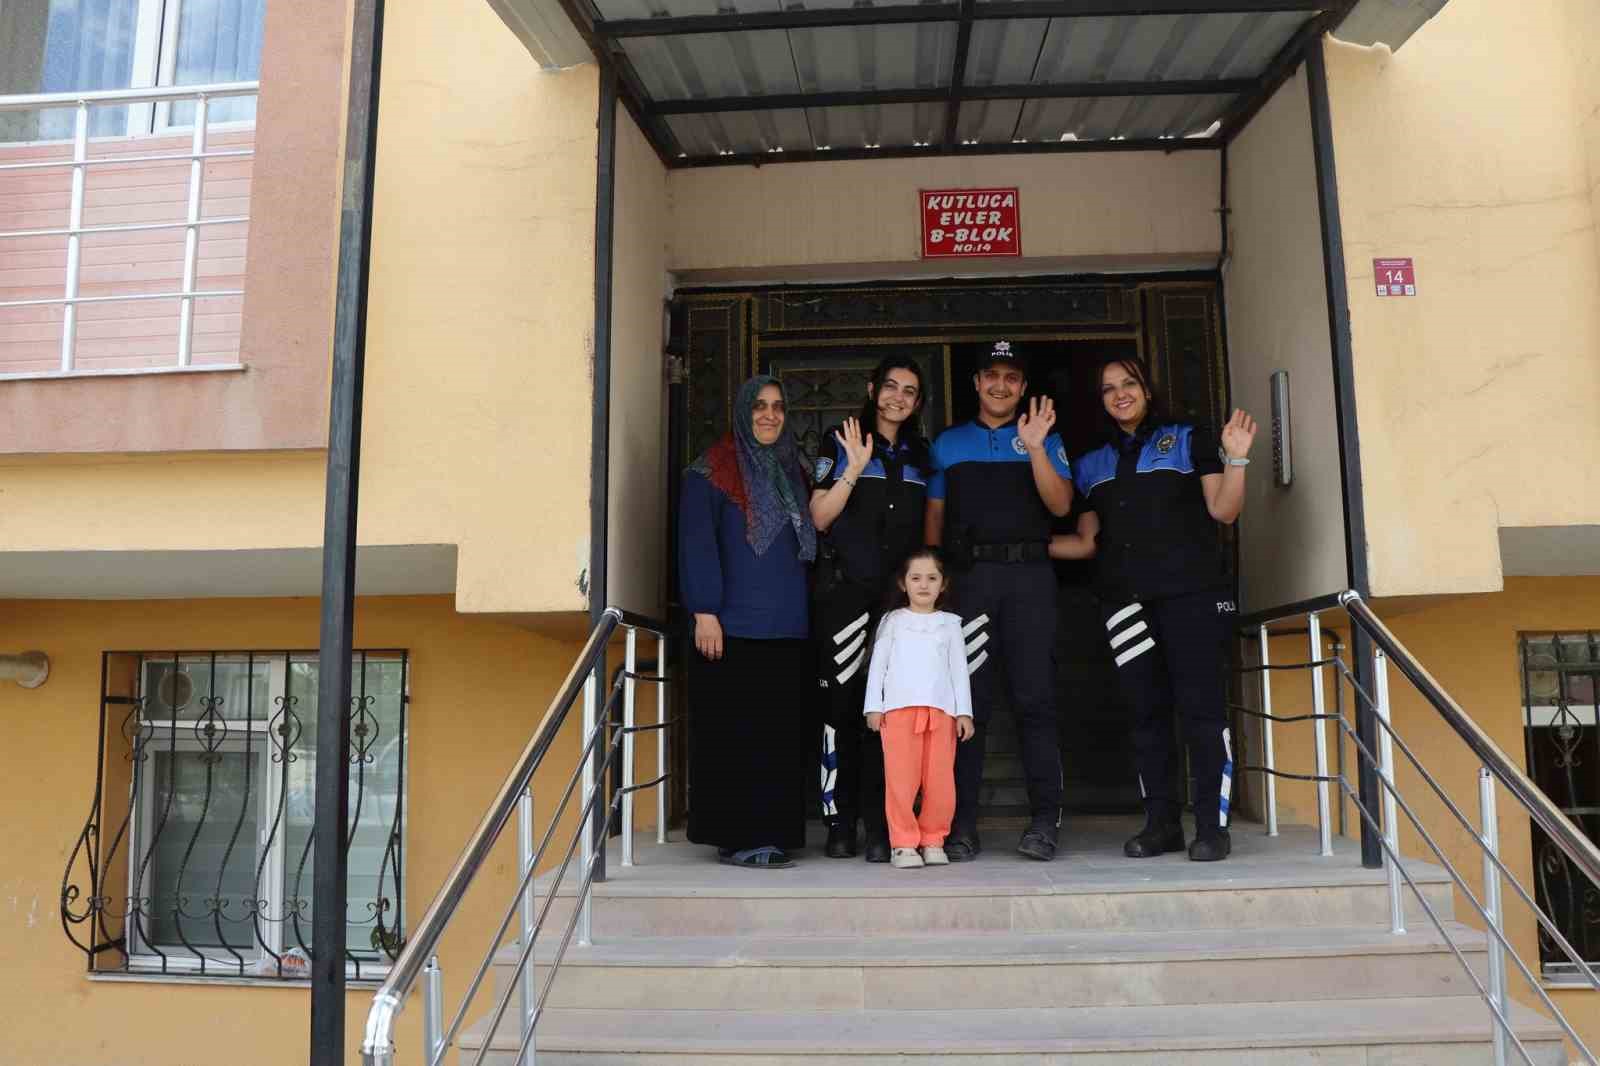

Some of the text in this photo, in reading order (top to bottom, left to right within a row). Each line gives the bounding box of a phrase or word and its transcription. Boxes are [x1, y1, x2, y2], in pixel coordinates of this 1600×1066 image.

[927, 194, 1014, 209] KUTLUCA
[940, 211, 1001, 225] EVLER
[930, 228, 1013, 243] B-BLOK
[1385, 270, 1404, 283] 14
